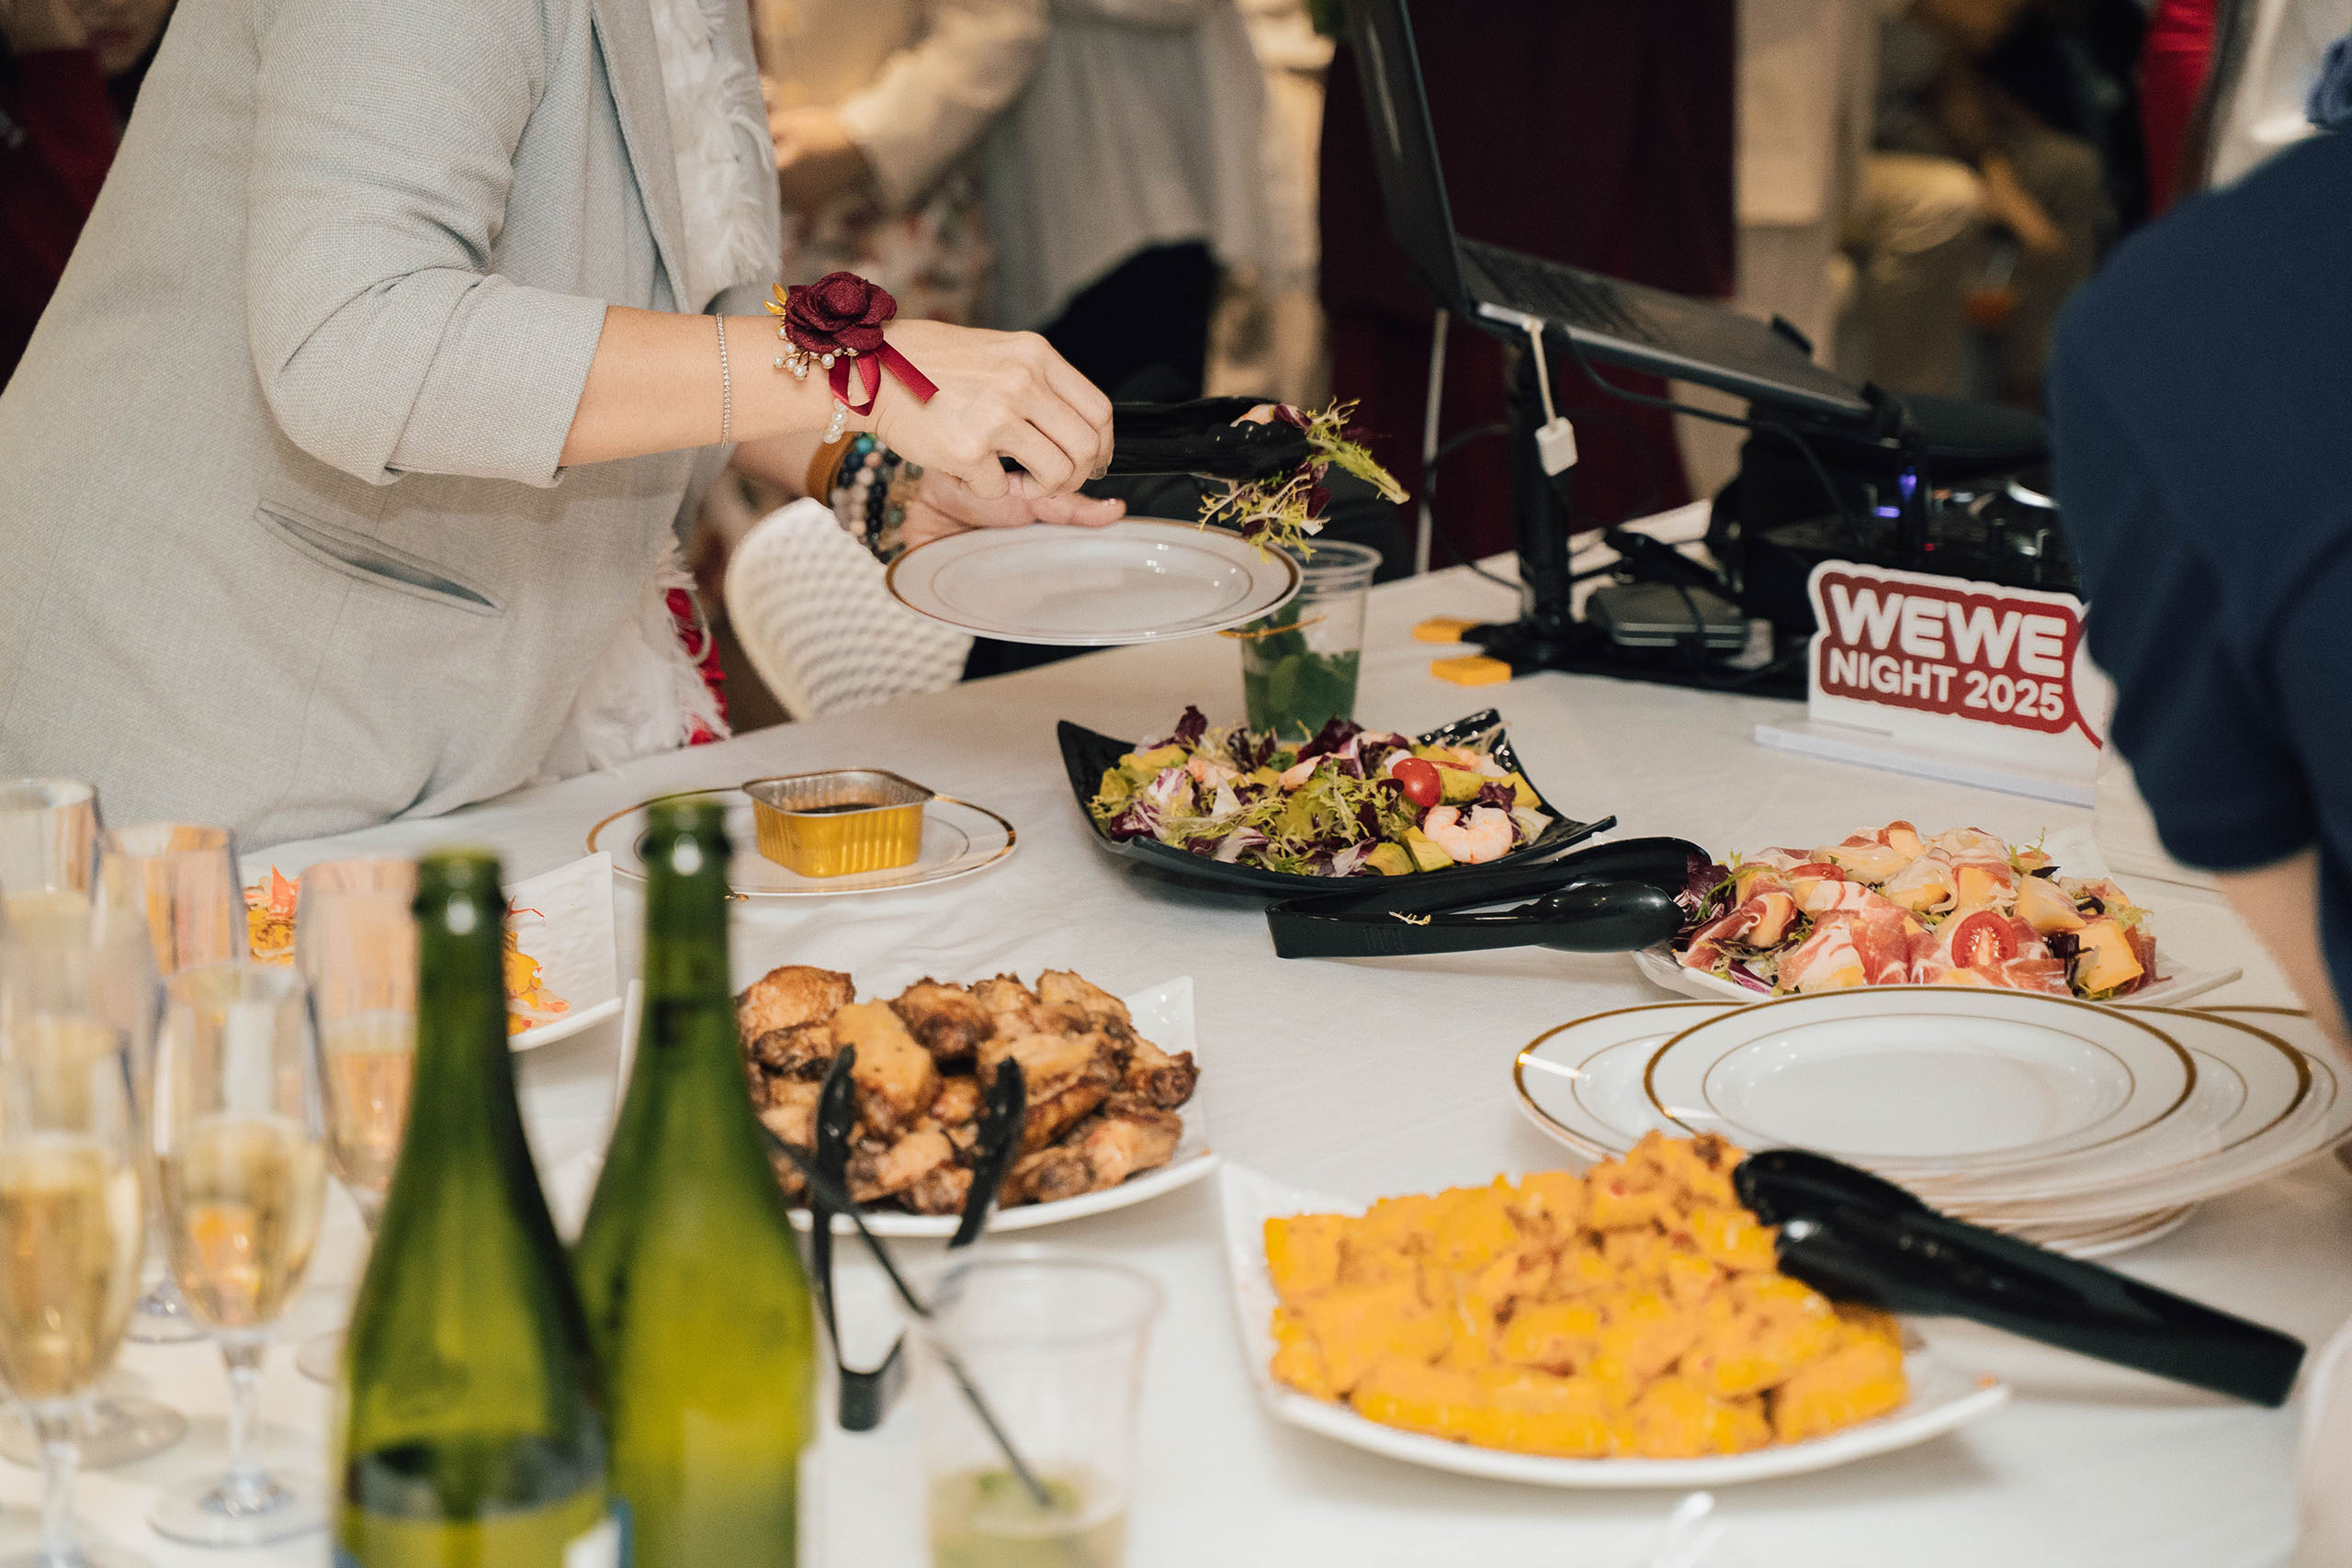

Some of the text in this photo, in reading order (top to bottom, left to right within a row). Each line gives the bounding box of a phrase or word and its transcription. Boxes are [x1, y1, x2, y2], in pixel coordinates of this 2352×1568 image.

[1830, 584, 2066, 678] WEWE
[1829, 648, 2064, 720] NIGHT 2025
